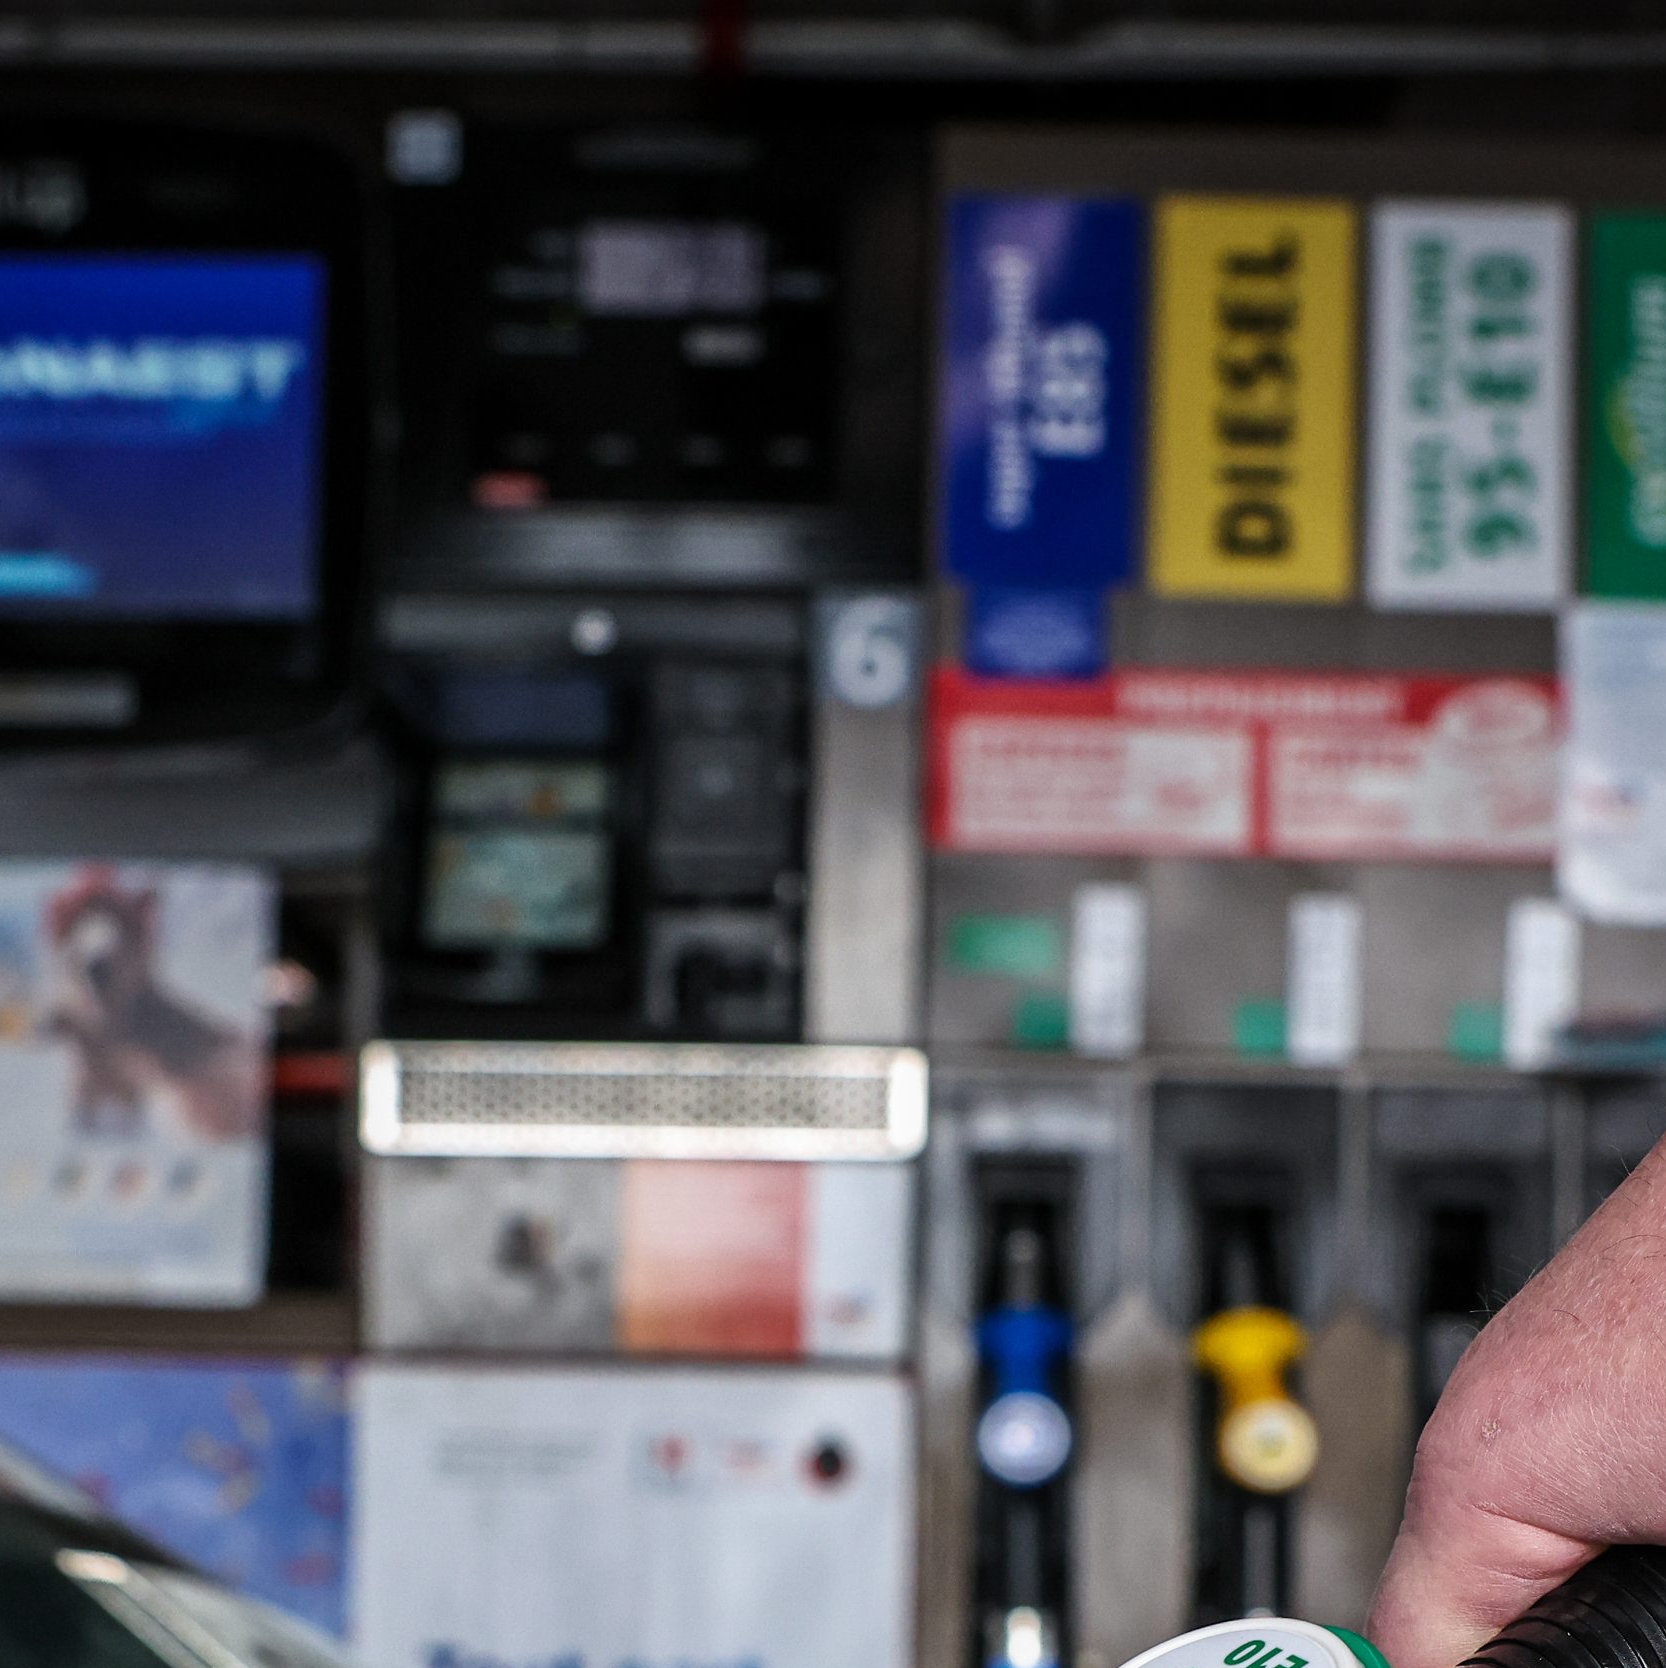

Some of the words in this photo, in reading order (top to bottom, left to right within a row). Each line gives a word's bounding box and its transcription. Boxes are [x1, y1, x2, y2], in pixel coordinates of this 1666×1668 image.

[1211, 232, 1300, 559] DIESEL
[1459, 247, 1539, 561] 95-E10
[832, 597, 909, 706] 6
